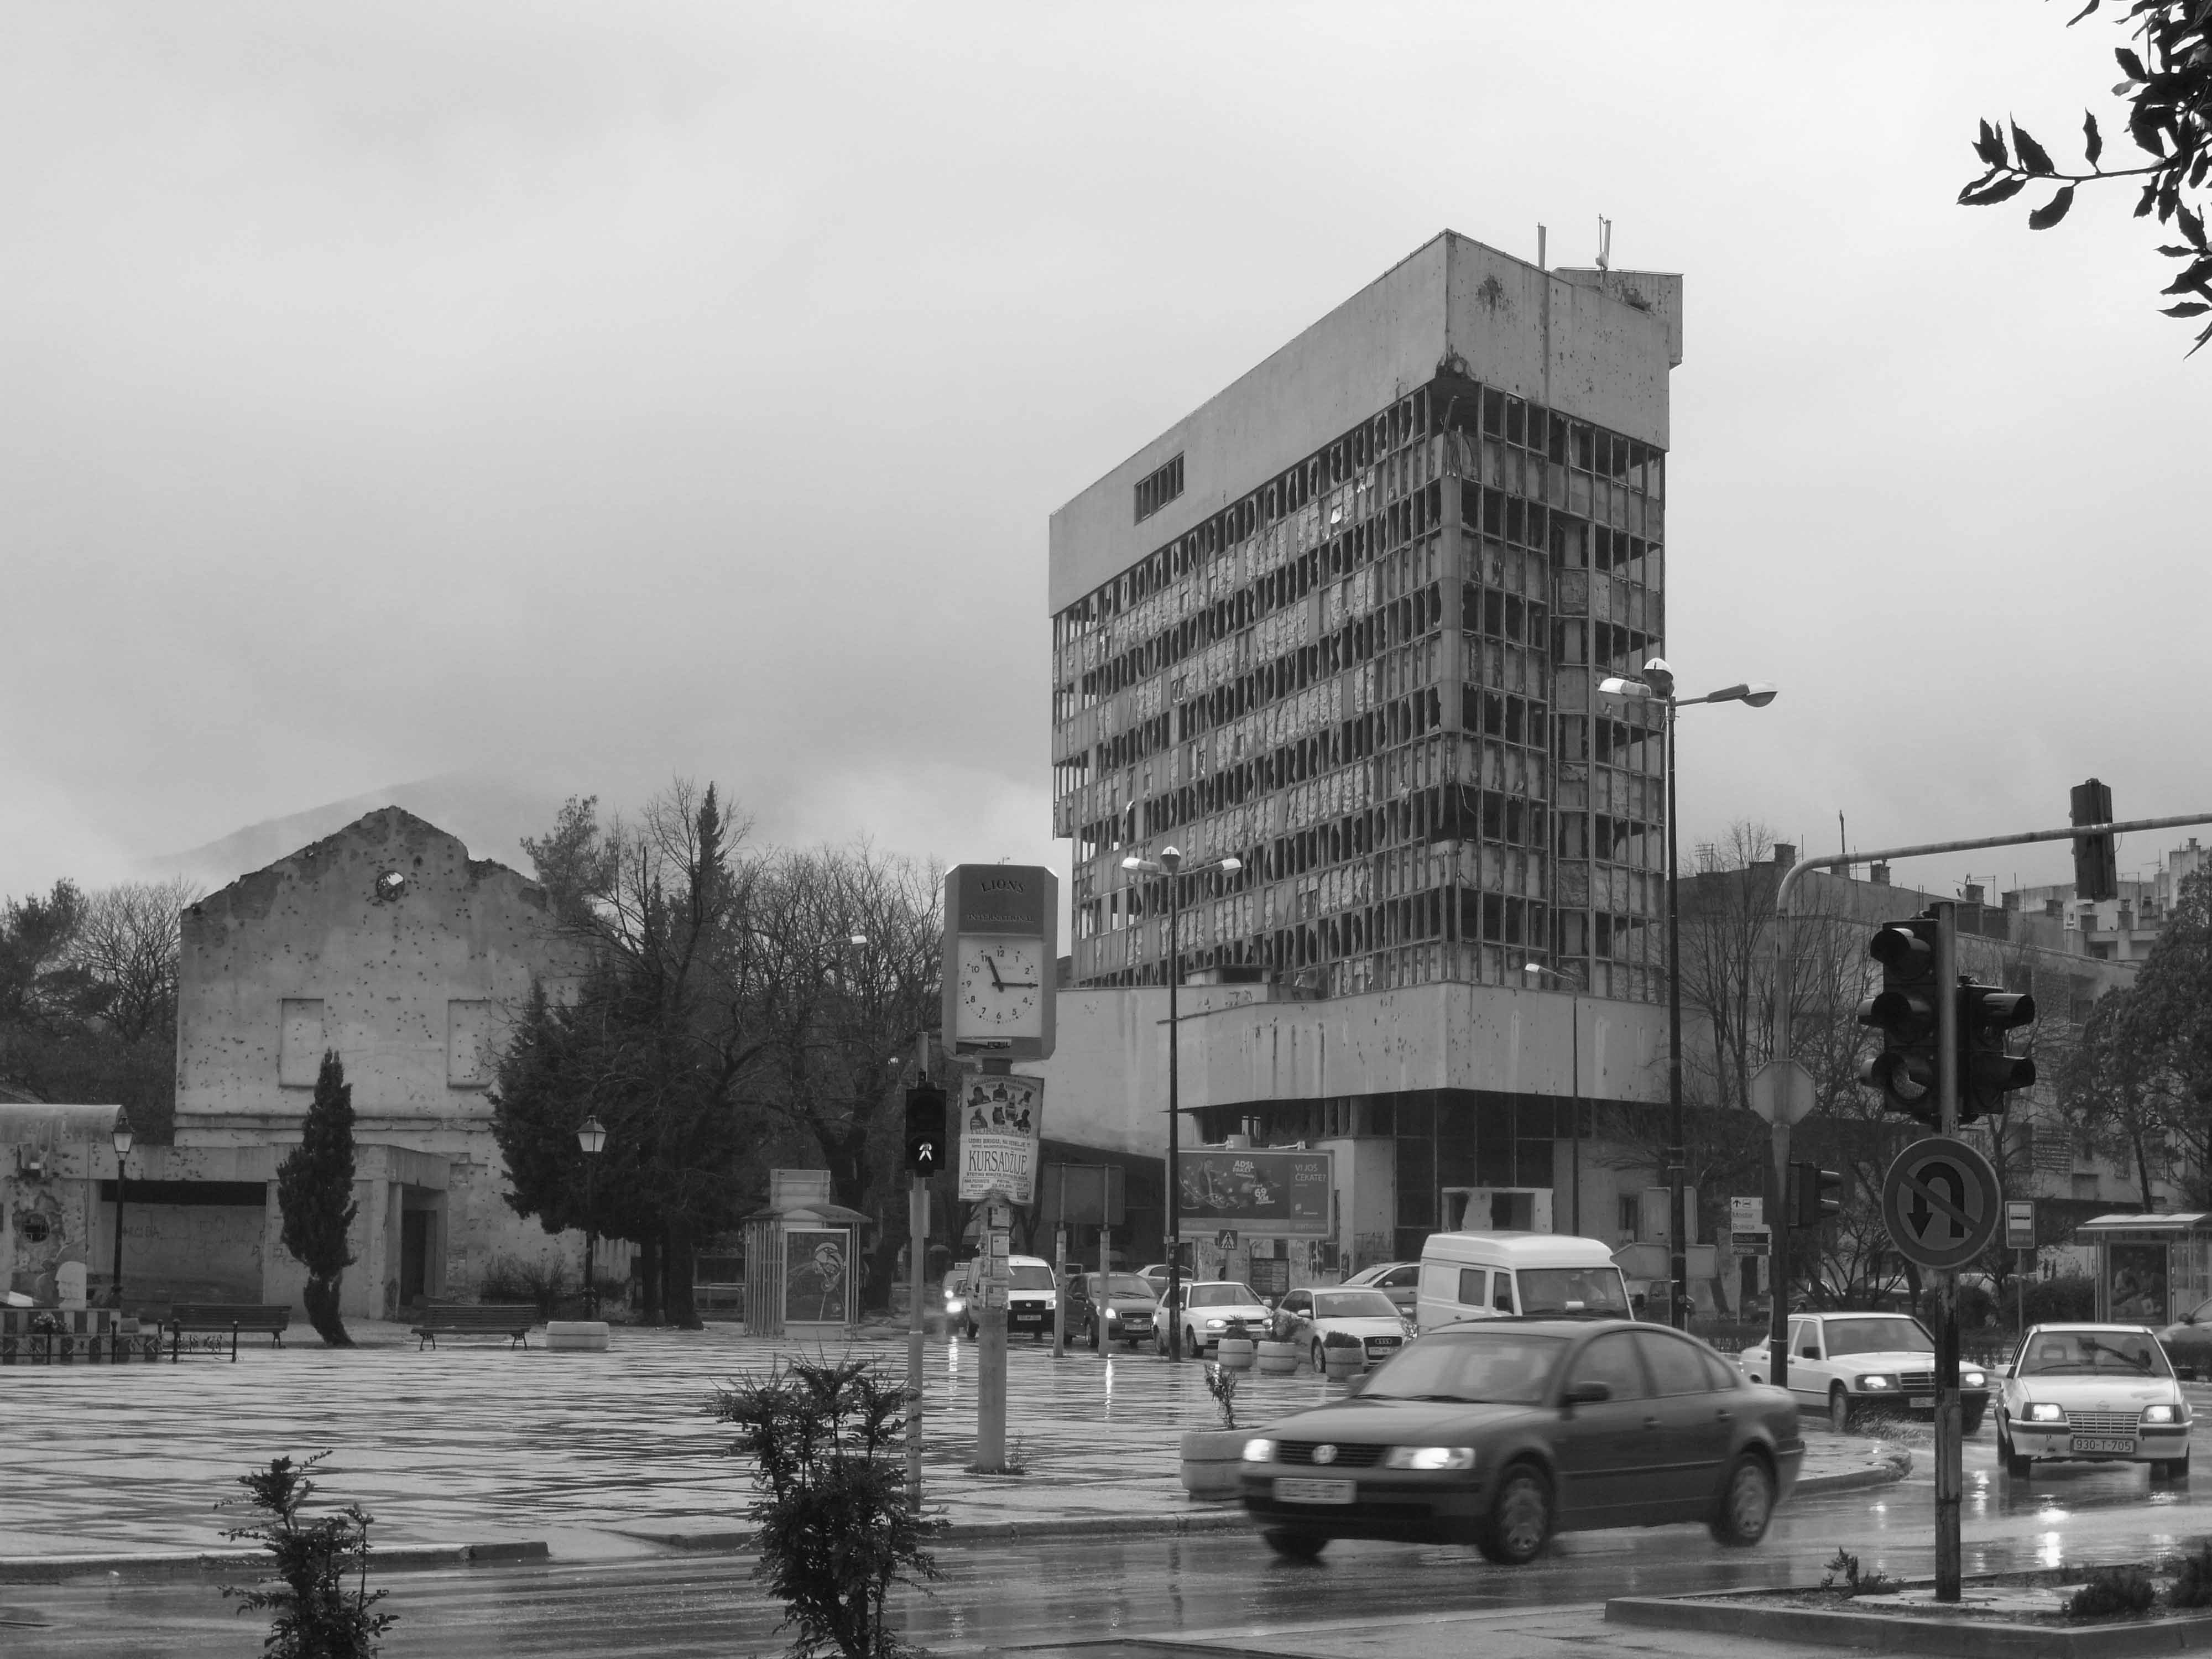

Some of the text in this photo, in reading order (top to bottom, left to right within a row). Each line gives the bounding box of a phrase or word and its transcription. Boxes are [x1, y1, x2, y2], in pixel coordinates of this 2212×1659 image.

[981, 880, 1025, 893] LIONS
[969, 1150, 1027, 1175] KURSADŽIJE
[1234, 1160, 1254, 1168] ADSL
[1254, 1187, 1267, 1197] 69
[2076, 1439, 2131, 1451] 930-T-705
